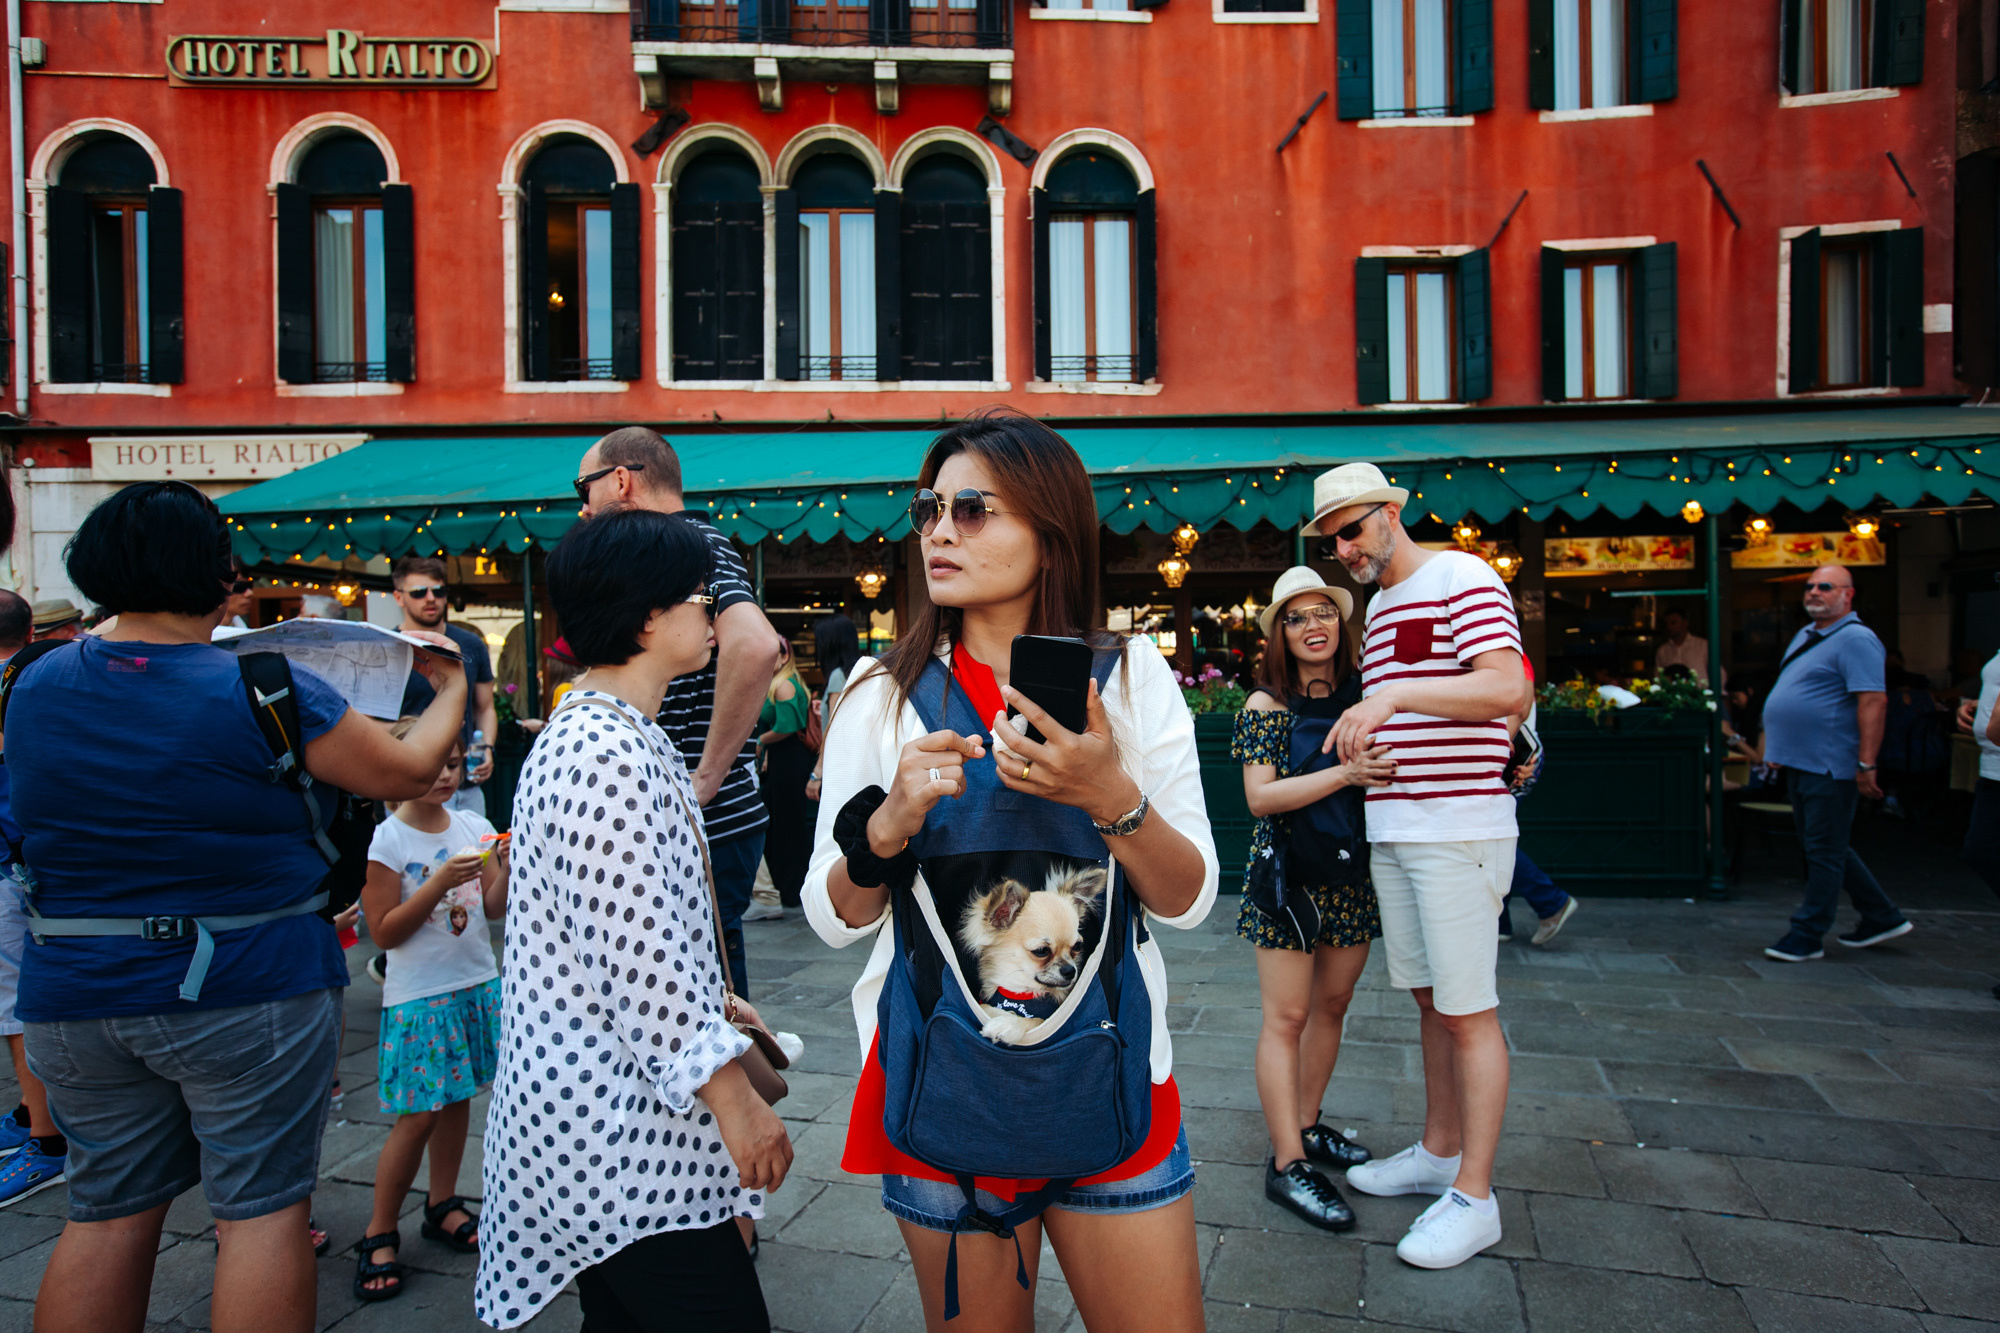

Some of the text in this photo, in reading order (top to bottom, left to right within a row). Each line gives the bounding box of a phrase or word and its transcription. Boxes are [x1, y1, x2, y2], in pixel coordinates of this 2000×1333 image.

[183, 29, 479, 77] HOTEL RIALTO
[116, 442, 342, 466] HOTEL RIALTO
